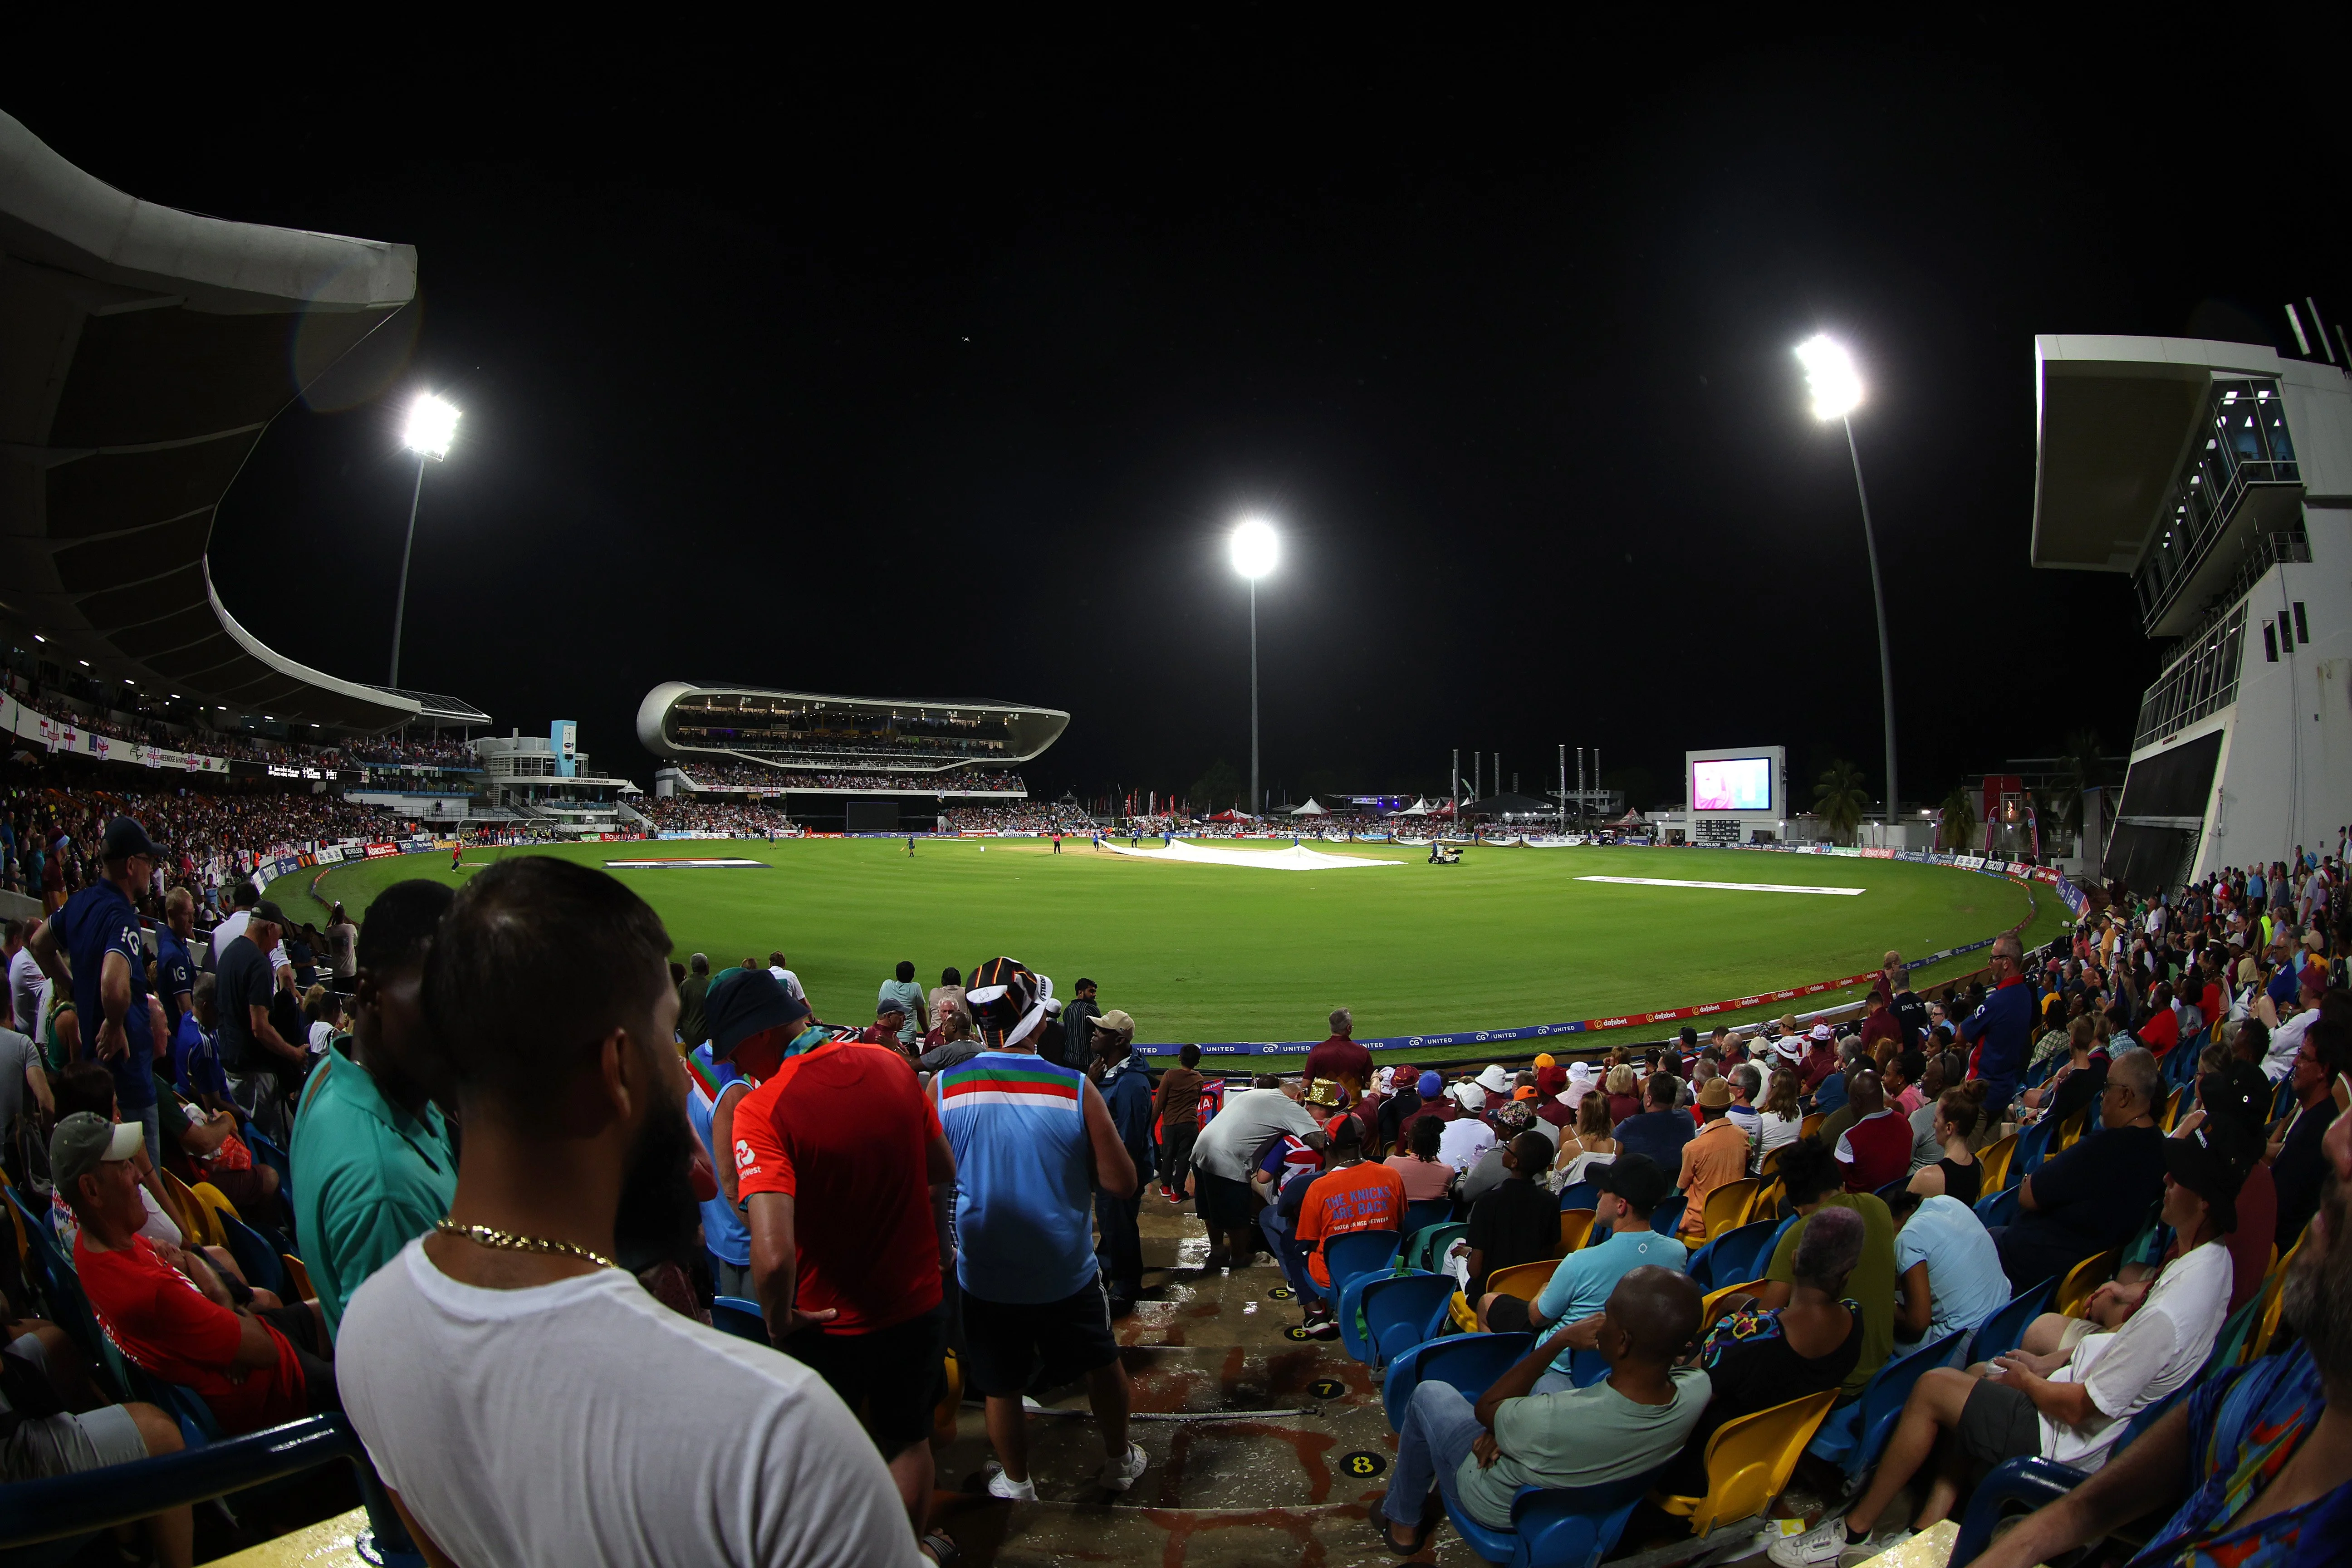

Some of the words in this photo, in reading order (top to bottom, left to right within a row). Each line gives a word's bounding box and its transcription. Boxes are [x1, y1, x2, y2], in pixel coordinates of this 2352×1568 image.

[368, 846, 386, 856] Abacus
[1895, 851, 1909, 860] IHG
[1928, 853, 1940, 863] IHG
[287, 863, 297, 872] UNITED
[1984, 860, 2004, 872] macron
[173, 966, 186, 982] IG
[1778, 990, 1794, 999] dafabet
[1741, 997, 1759, 1006] dafabet
[1700, 1004, 1720, 1013] dafabet
[1654, 1011, 1676, 1020] dafabet
[1603, 1018, 1627, 1027] dafabet
[1325, 1193, 1347, 1210] THE
[1349, 1186, 1392, 1203] KNICKS
[1333, 1205, 1354, 1220] ARE
[1358, 1200, 1389, 1215] BACK
[1276, 1289, 1288, 1302] 5
[1293, 1328, 1306, 1338] 6
[1318, 1384, 1332, 1394] 7
[1352, 1457, 1374, 1473] 8
